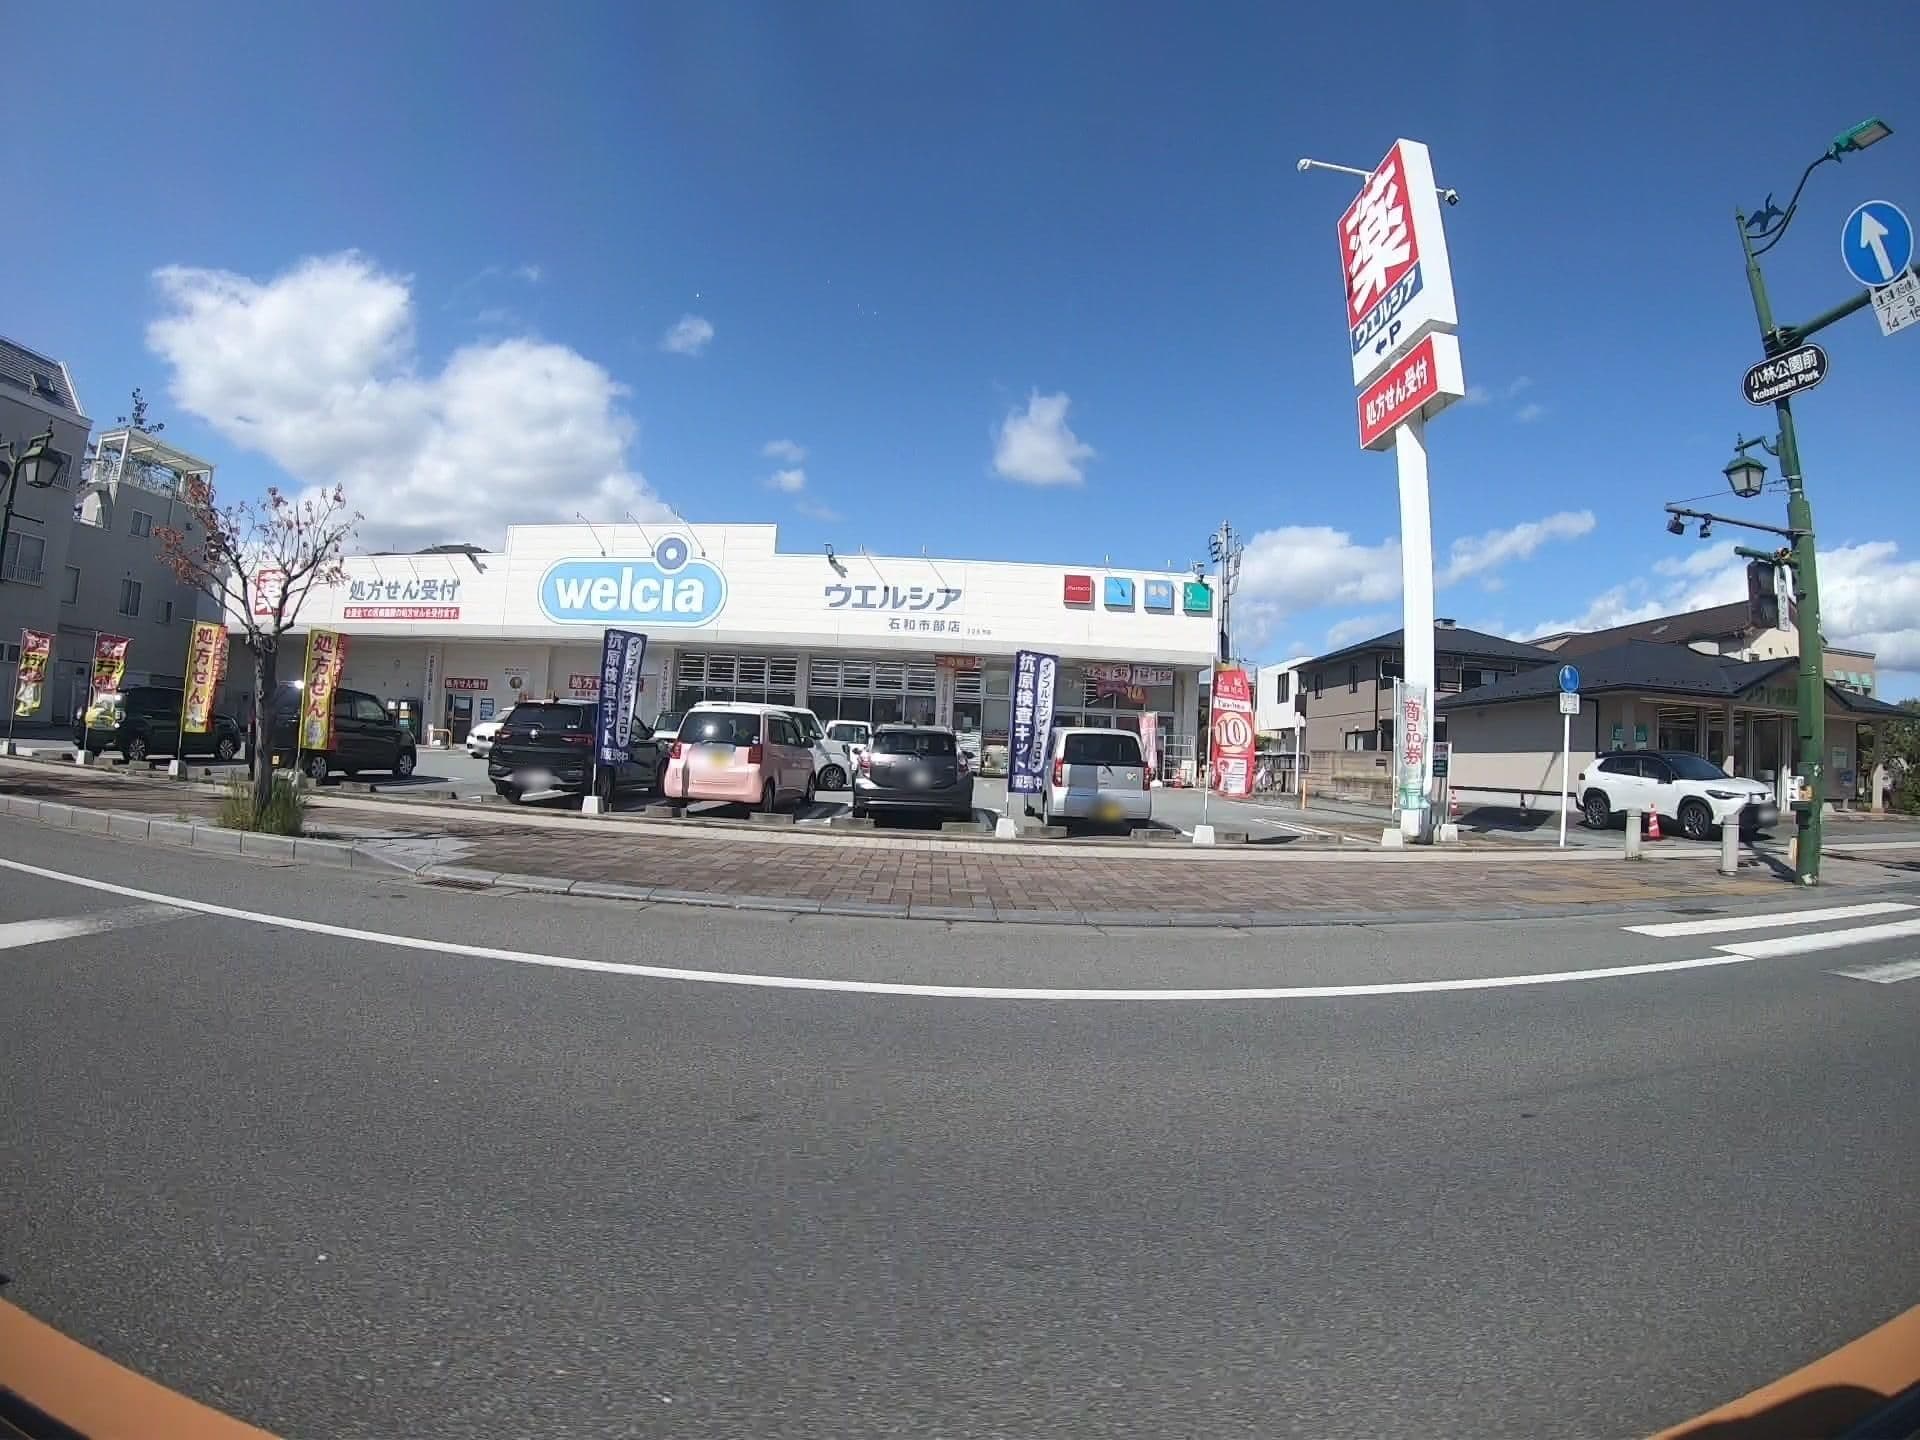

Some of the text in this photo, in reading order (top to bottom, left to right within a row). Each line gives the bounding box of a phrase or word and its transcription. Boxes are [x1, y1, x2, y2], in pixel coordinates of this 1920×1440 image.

[1345, 160, 1411, 315] 薬
[1353, 269, 1416, 348] ウエルシア
[1388, 318, 1402, 346] P
[1365, 356, 1429, 427] 処方せん受付
[1750, 349, 1818, 389] 小林公園前
[1752, 368, 1820, 401] Kobayashi Park
[349, 578, 461, 601] 処方せん受付
[555, 566, 705, 613] welcia
[824, 583, 962, 611] ウエルシア
[888, 617, 961, 633] 石和市部店
[188, 627, 214, 708] 処方せん
[307, 634, 333, 718] 処方せん
[602, 631, 625, 745] 抗原検査キット
[1014, 653, 1037, 773] 抗原検査キット
[1404, 698, 1424, 765] 商品券
